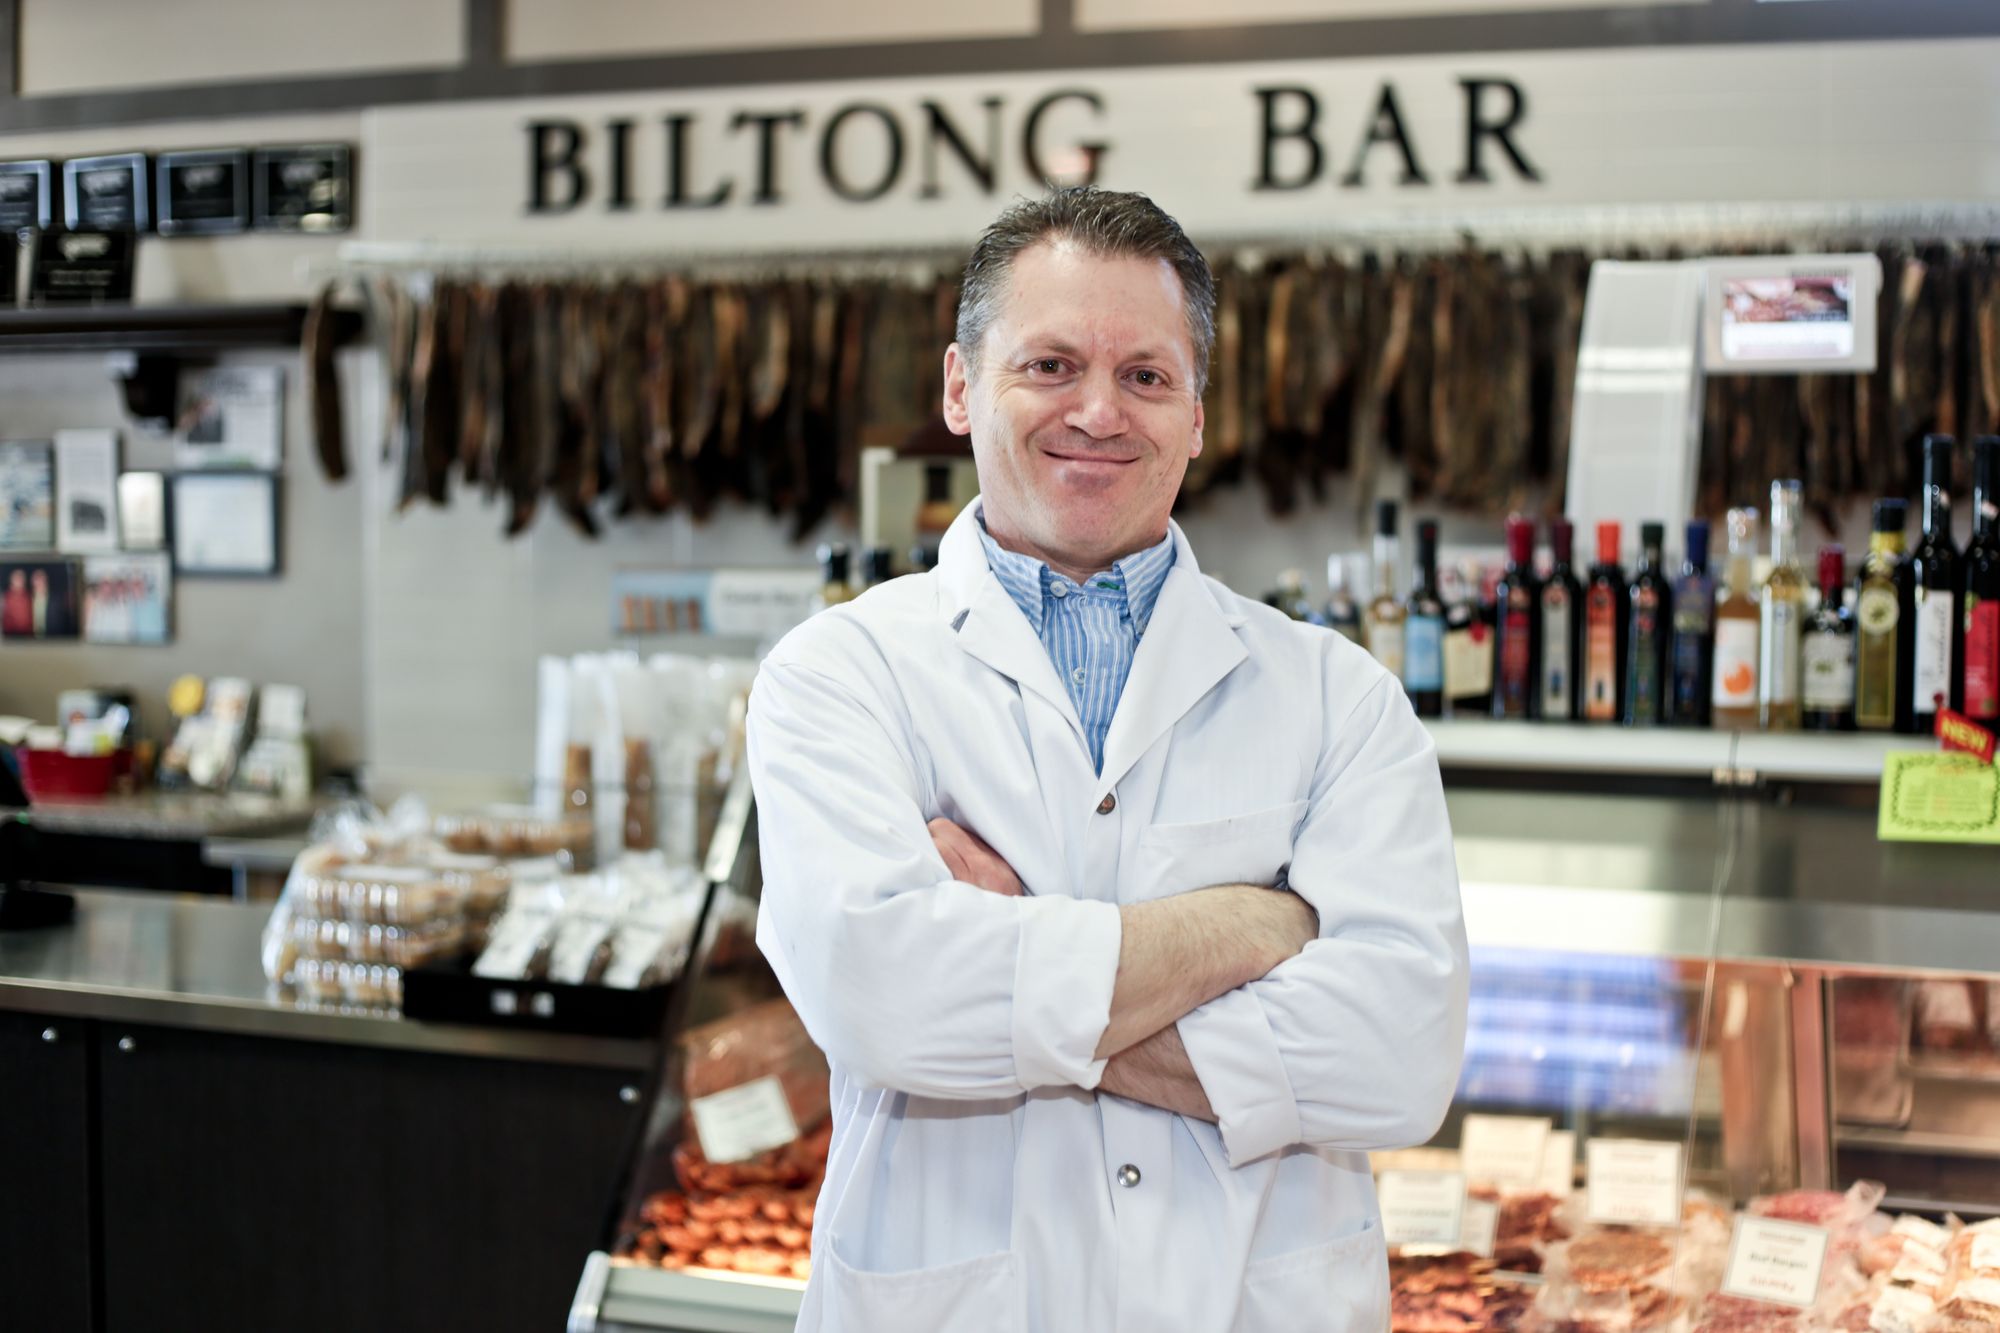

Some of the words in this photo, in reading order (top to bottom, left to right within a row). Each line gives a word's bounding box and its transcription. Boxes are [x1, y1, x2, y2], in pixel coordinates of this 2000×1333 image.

[524, 87, 1112, 216] BILTONG
[1250, 76, 1543, 191] BAR
[1941, 714, 1988, 754] NEW
